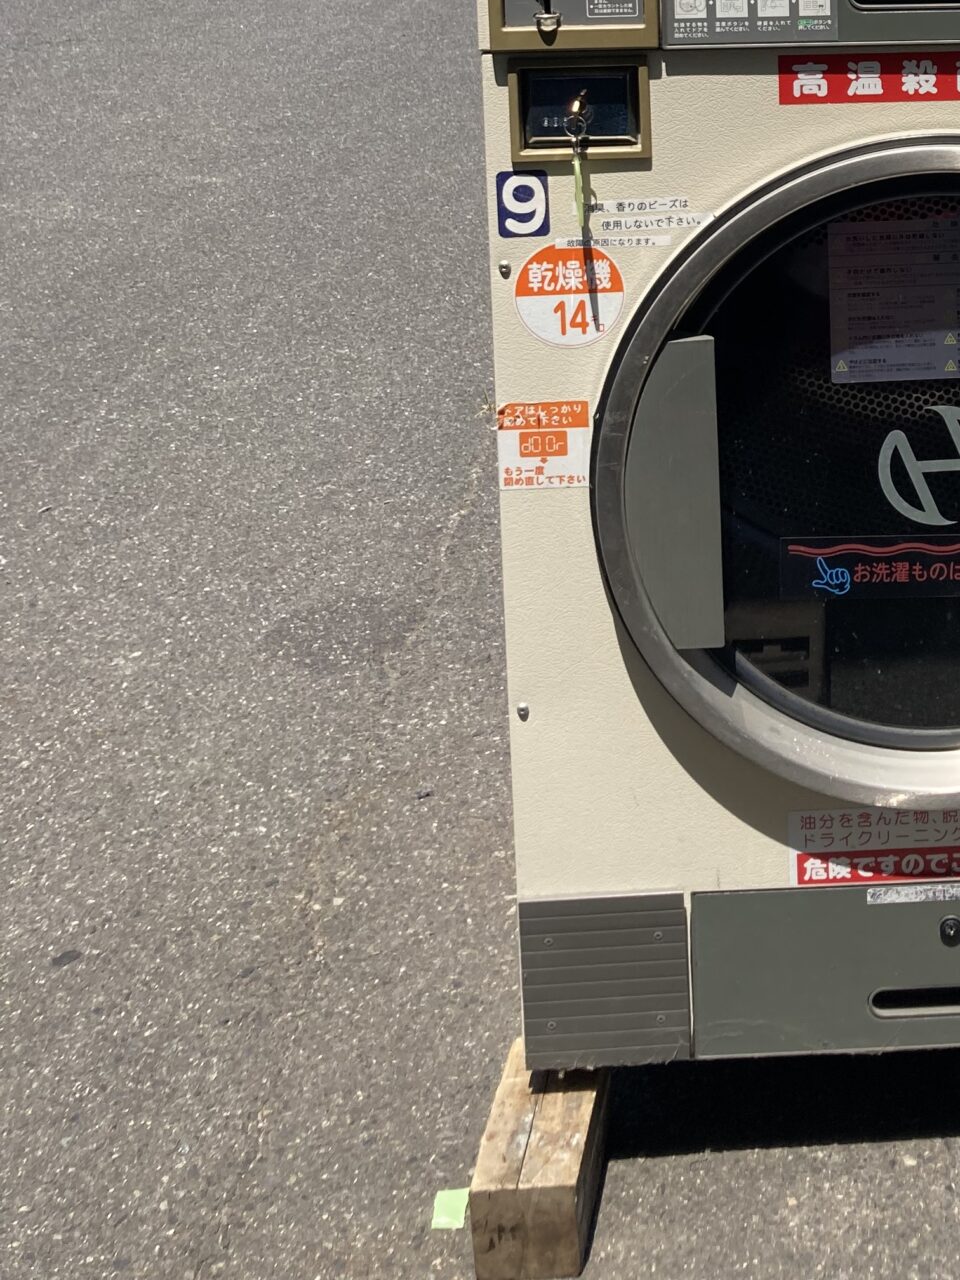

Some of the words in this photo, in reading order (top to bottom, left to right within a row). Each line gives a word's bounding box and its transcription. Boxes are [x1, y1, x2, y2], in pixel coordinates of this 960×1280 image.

[502, 174, 546, 235] 9
[601, 217, 701, 231] 使用しないで下さい。
[527, 259, 612, 292] 乾燥機
[553, 300, 589, 336] 14
[503, 475, 586, 487] 閉め直して下さい
[504, 465, 545, 476] もう一度
